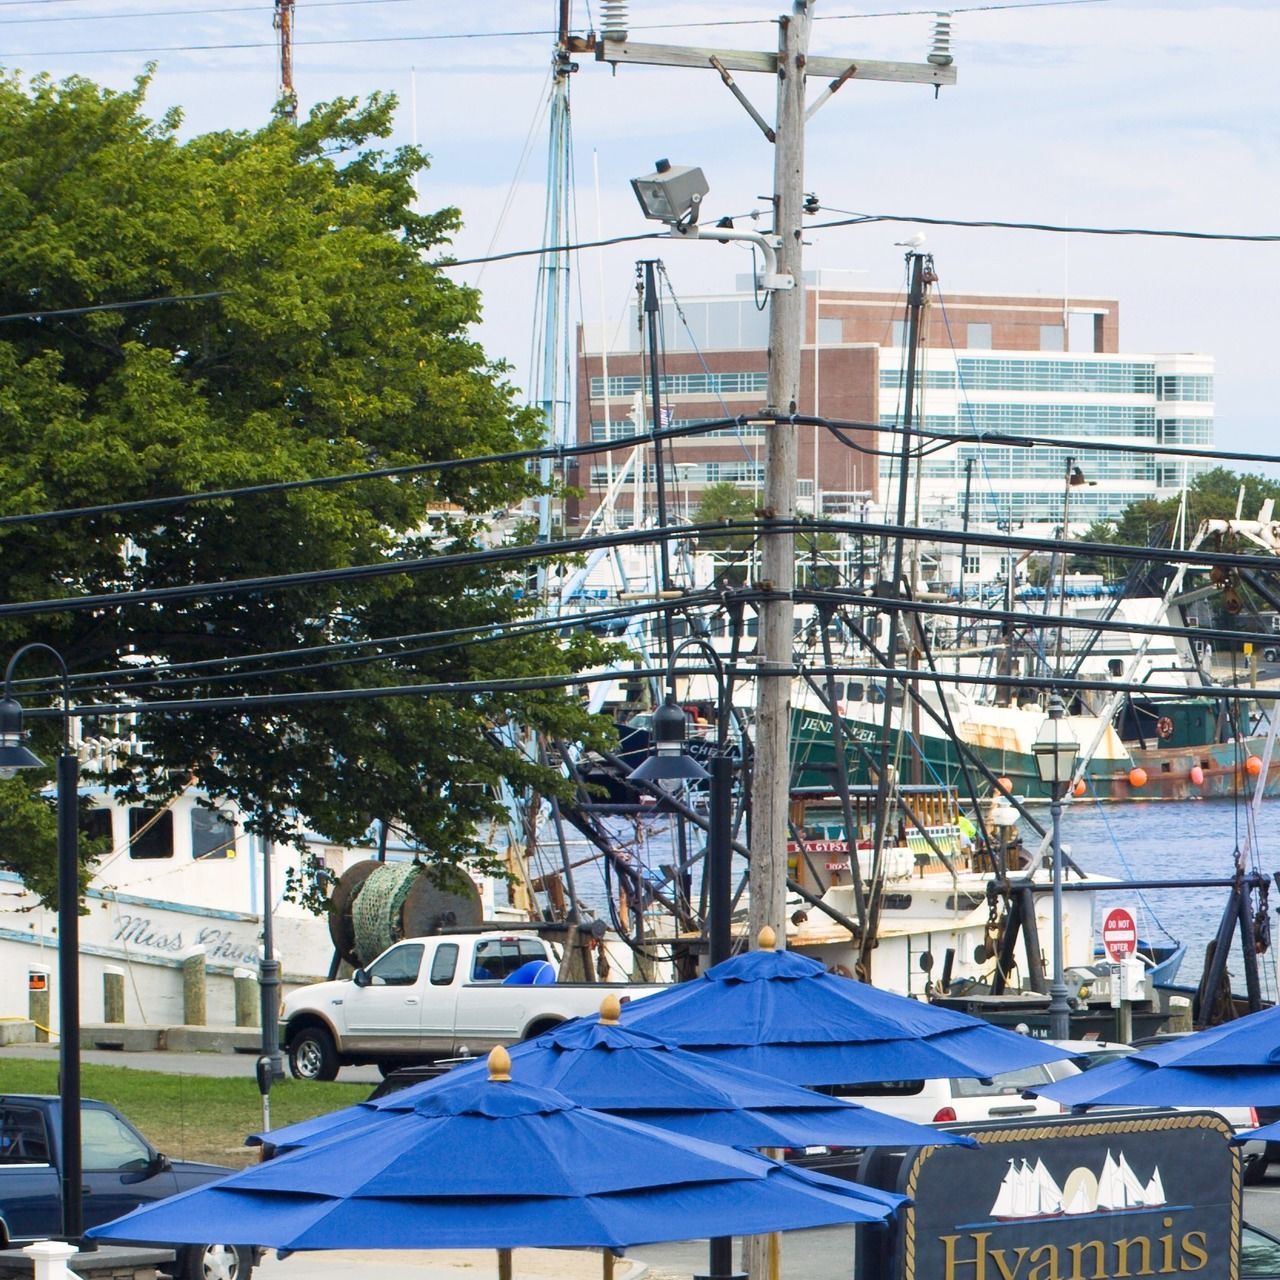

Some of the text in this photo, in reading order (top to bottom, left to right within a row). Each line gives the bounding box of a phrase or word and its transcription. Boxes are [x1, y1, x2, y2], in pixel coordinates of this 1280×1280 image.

[794, 842, 848, 852] SA GYPSY
[1108, 919, 1130, 929] DO NOT
[114, 914, 184, 951] Miss
[1110, 943, 1128, 952] ENTER
